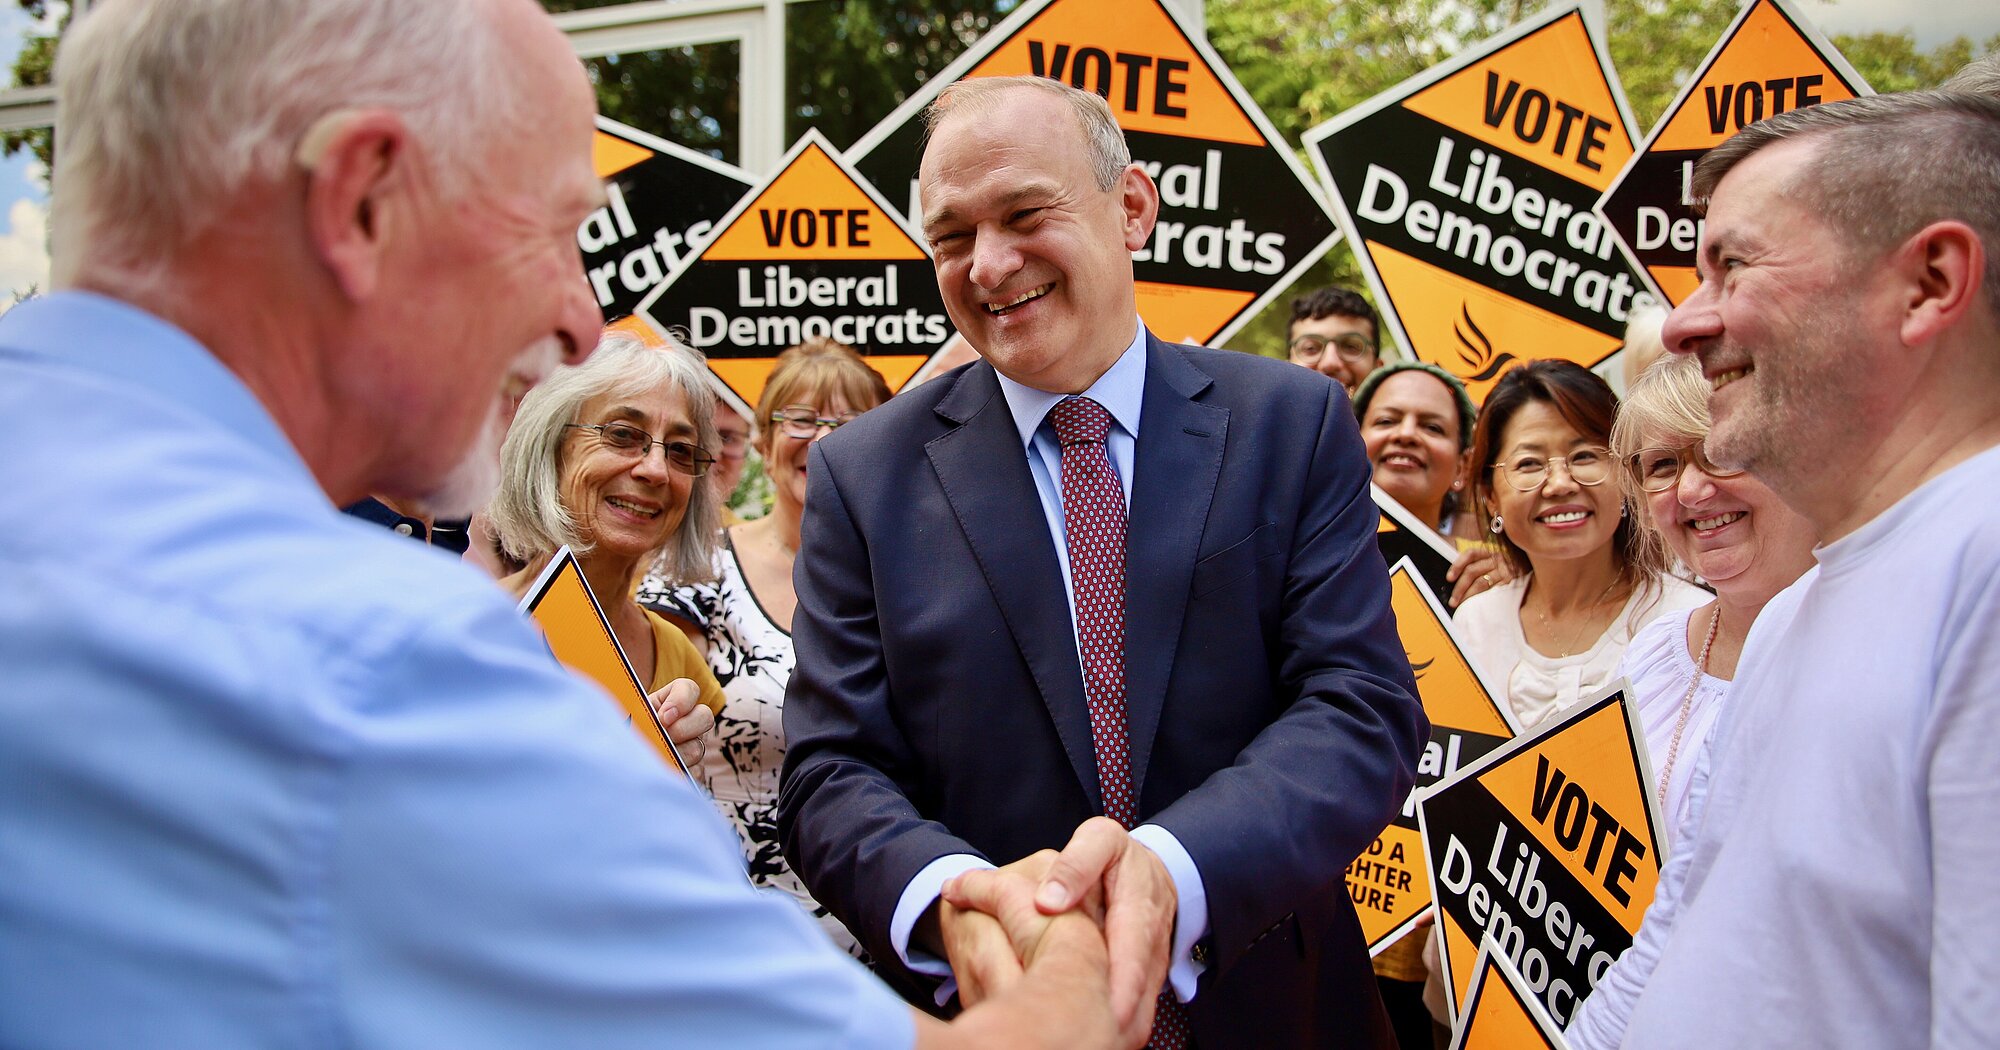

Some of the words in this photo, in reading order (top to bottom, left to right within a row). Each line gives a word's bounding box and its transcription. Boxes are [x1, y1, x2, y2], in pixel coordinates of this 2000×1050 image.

[1028, 41, 1189, 118] VOTE
[1705, 74, 1823, 134] VOTE
[1482, 70, 1612, 172] VOTE
[1429, 136, 1616, 261] Liberal
[760, 209, 870, 247] VOTE
[1132, 219, 1286, 275] rats
[1636, 206, 1704, 251] De
[737, 265, 898, 307] Liberal
[690, 307, 947, 346] Democrats
[1389, 842, 1405, 863] A
[1531, 752, 1646, 910] VOTE
